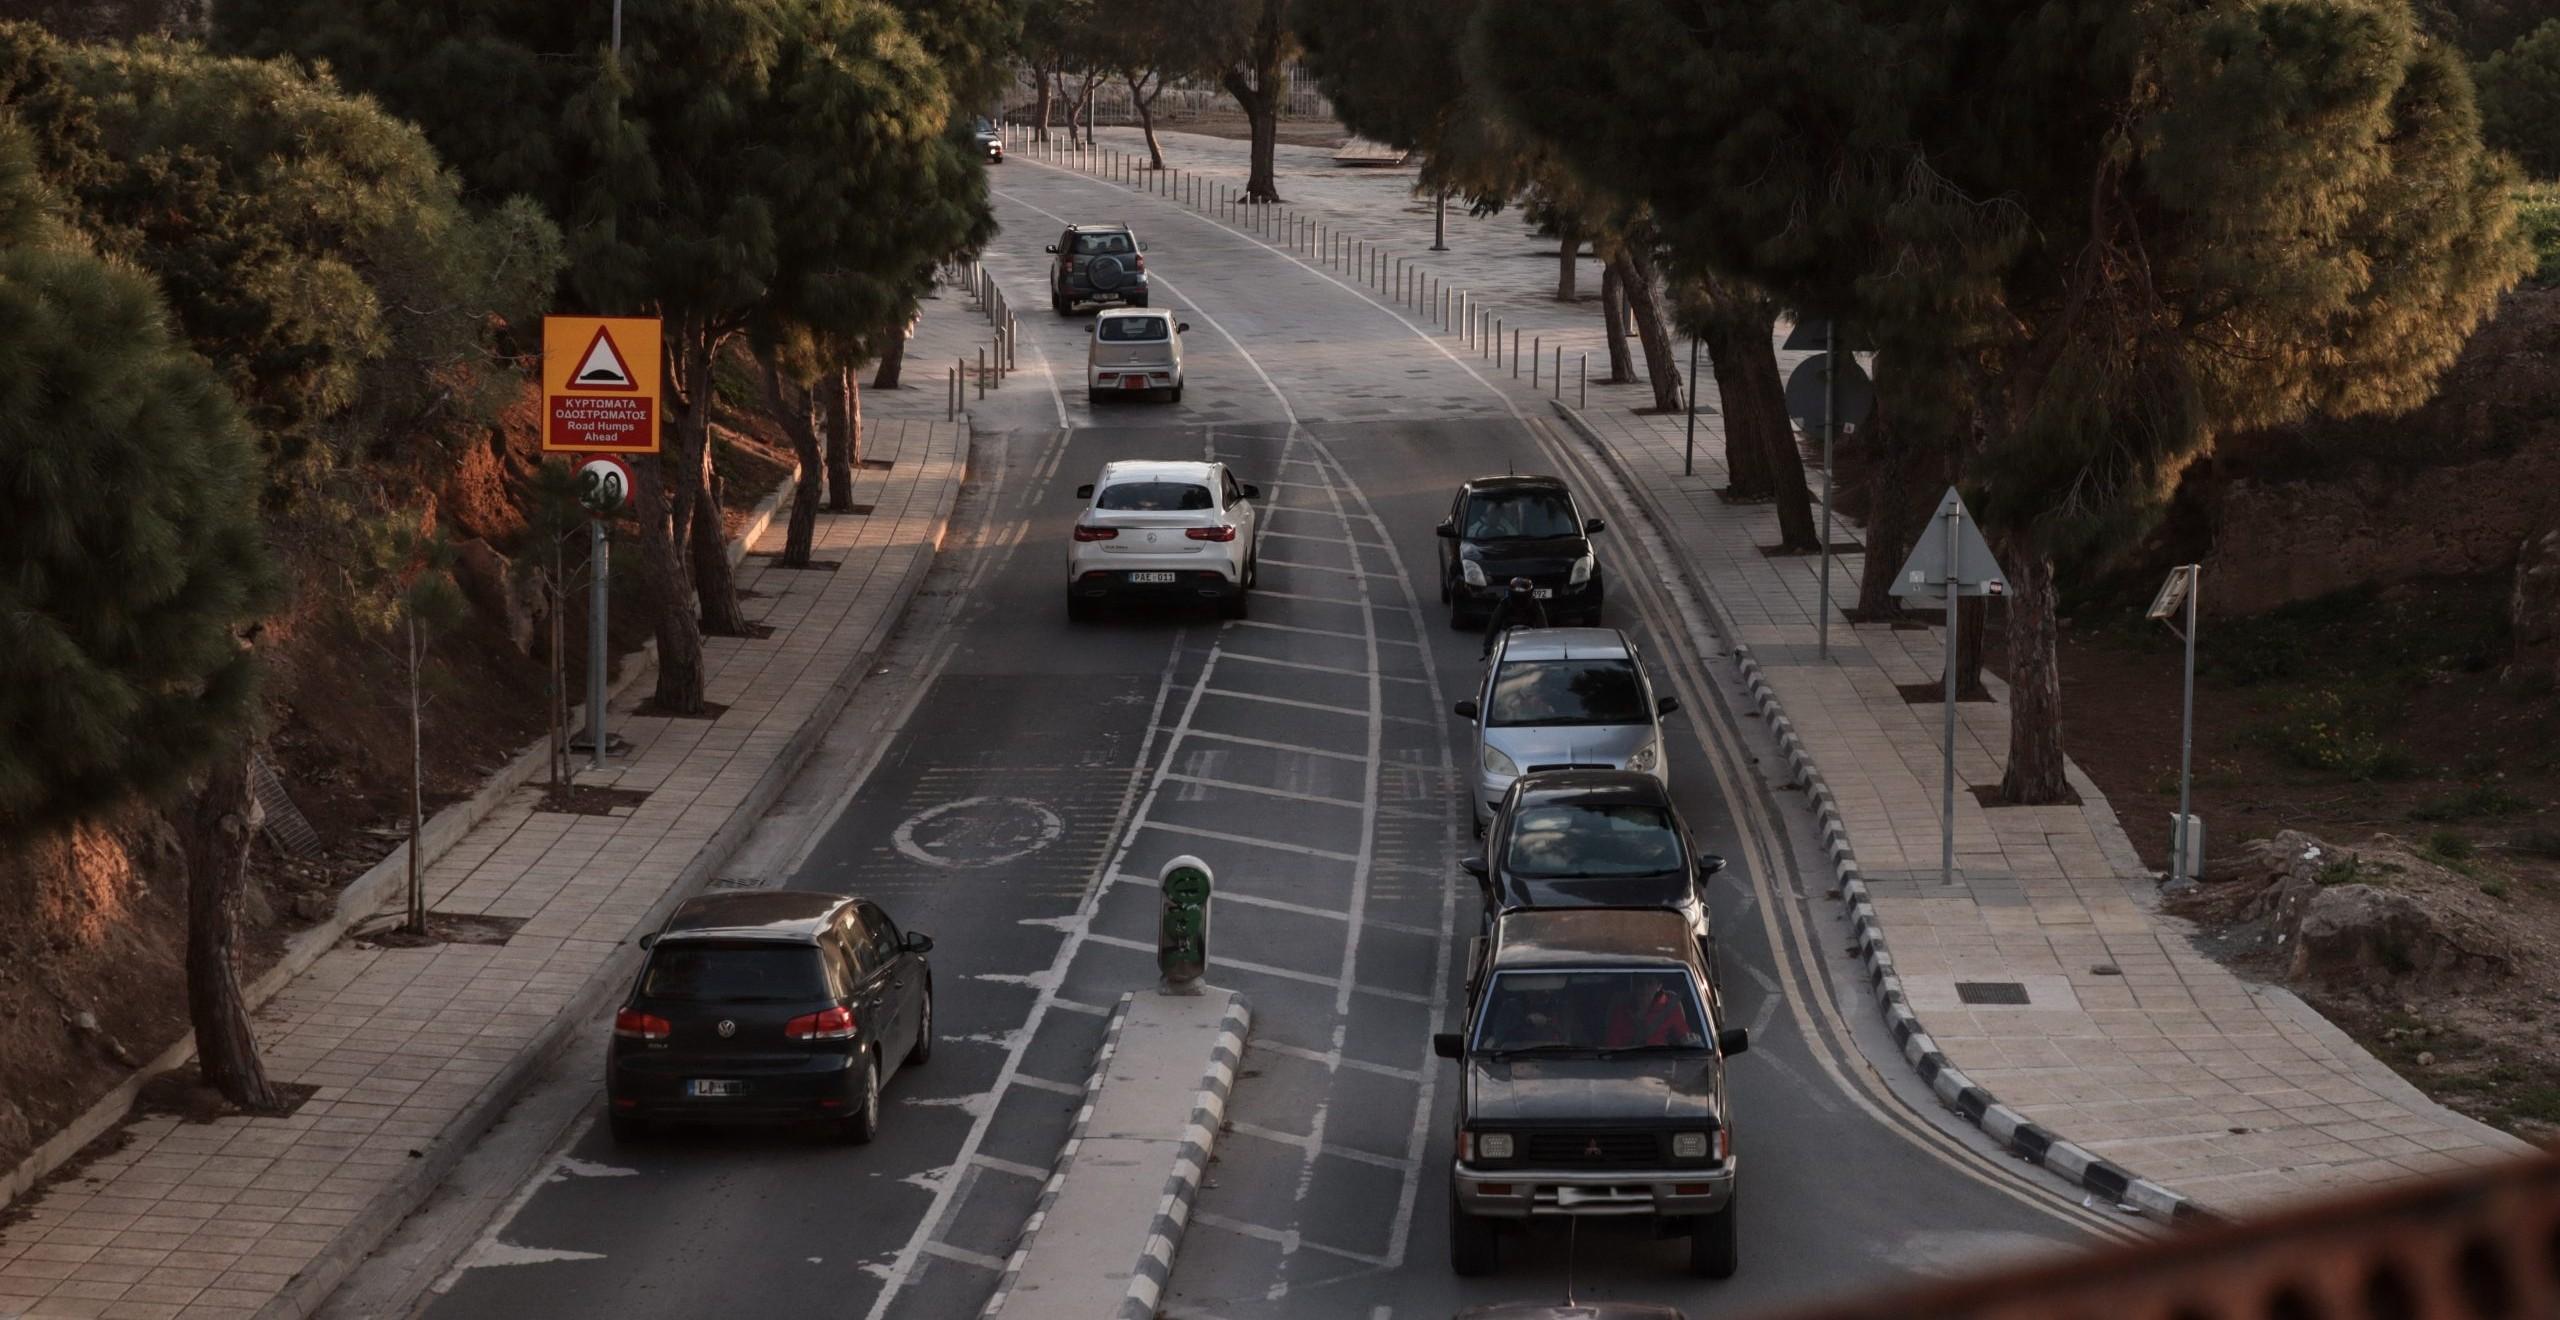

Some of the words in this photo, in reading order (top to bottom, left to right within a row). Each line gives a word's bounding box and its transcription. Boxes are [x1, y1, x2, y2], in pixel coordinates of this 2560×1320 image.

[565, 399, 636, 409] ΚΥΡΤΩΜΑΤΑ
[555, 409, 647, 420] ΟΔΟΣΤΡΩΜΑΤΟΣ
[567, 421, 595, 431] Road
[597, 422, 635, 433] Humps
[584, 432, 618, 441] Ahead
